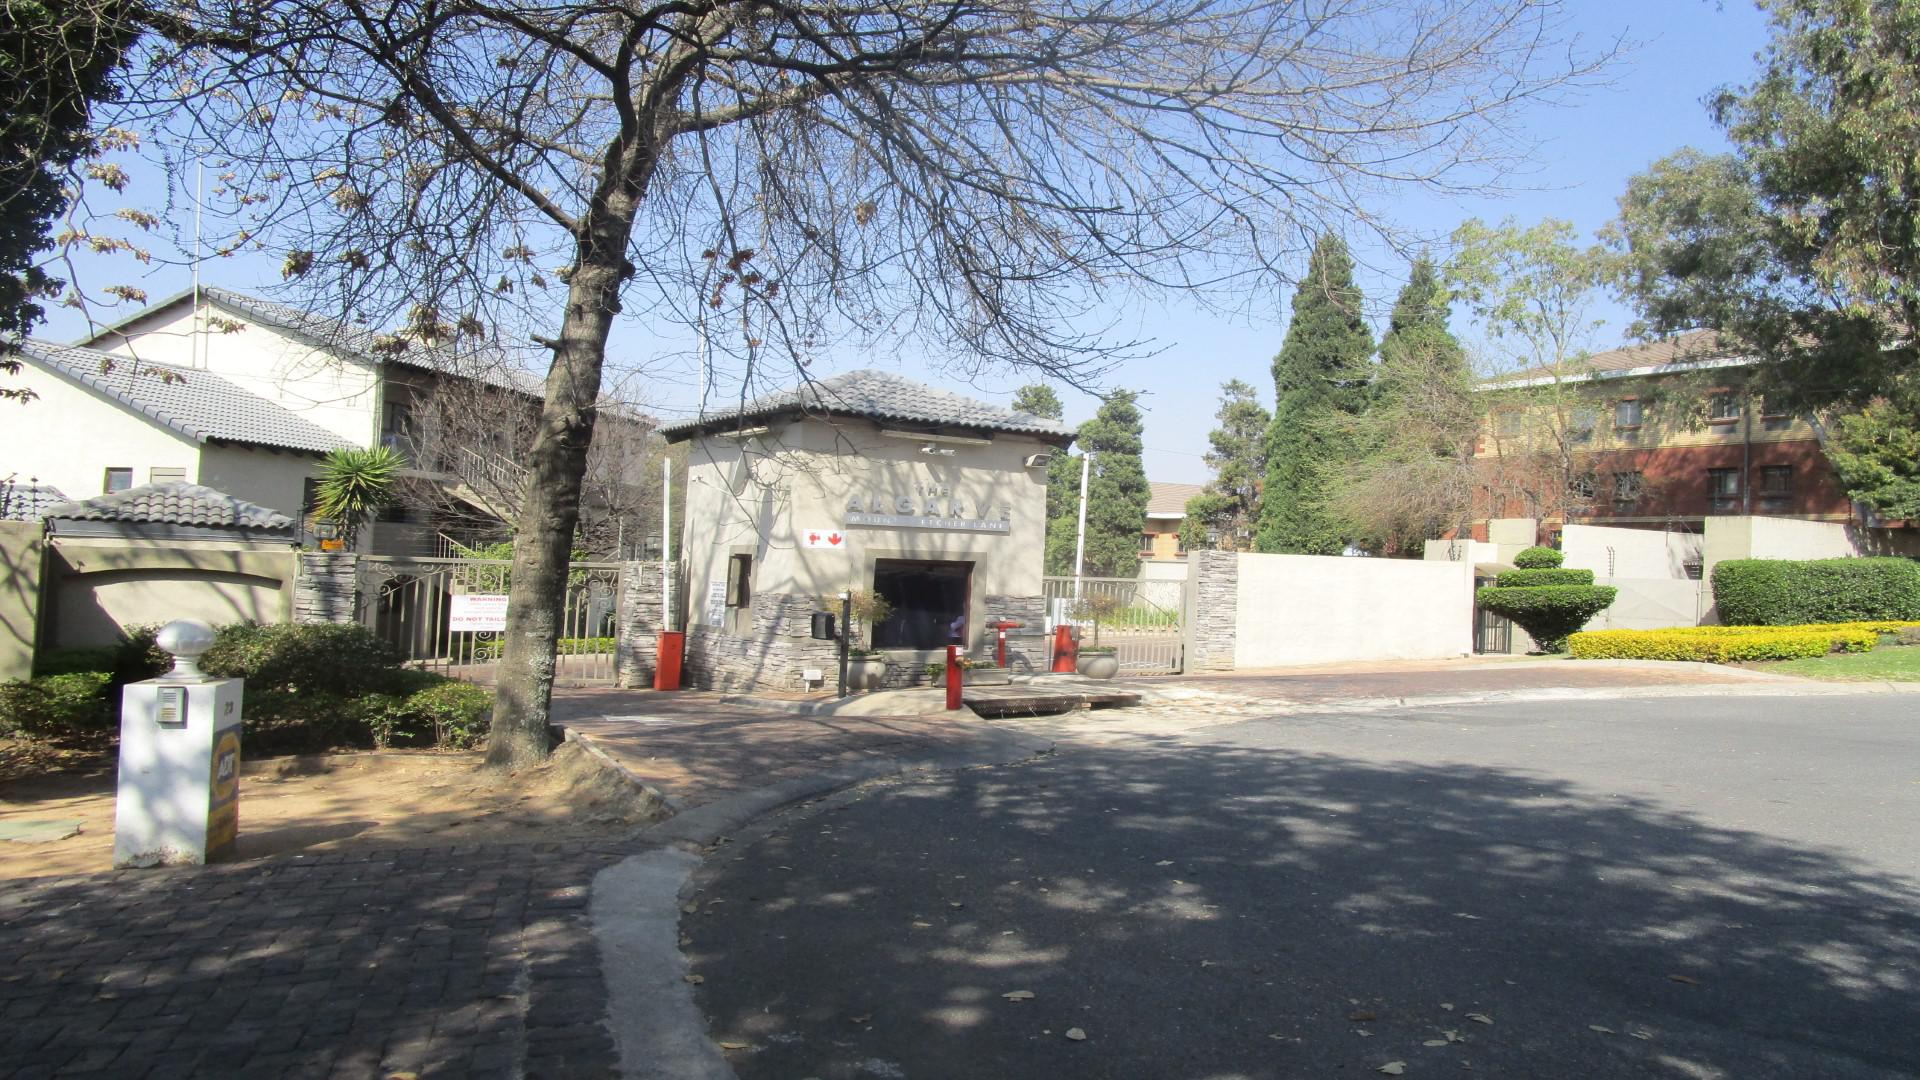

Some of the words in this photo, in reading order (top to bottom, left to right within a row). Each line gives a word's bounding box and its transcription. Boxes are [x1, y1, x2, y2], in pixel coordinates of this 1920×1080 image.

[915, 485, 950, 497] THE
[847, 494, 1010, 521] ALGARVE
[218, 754, 235, 779] ADT
